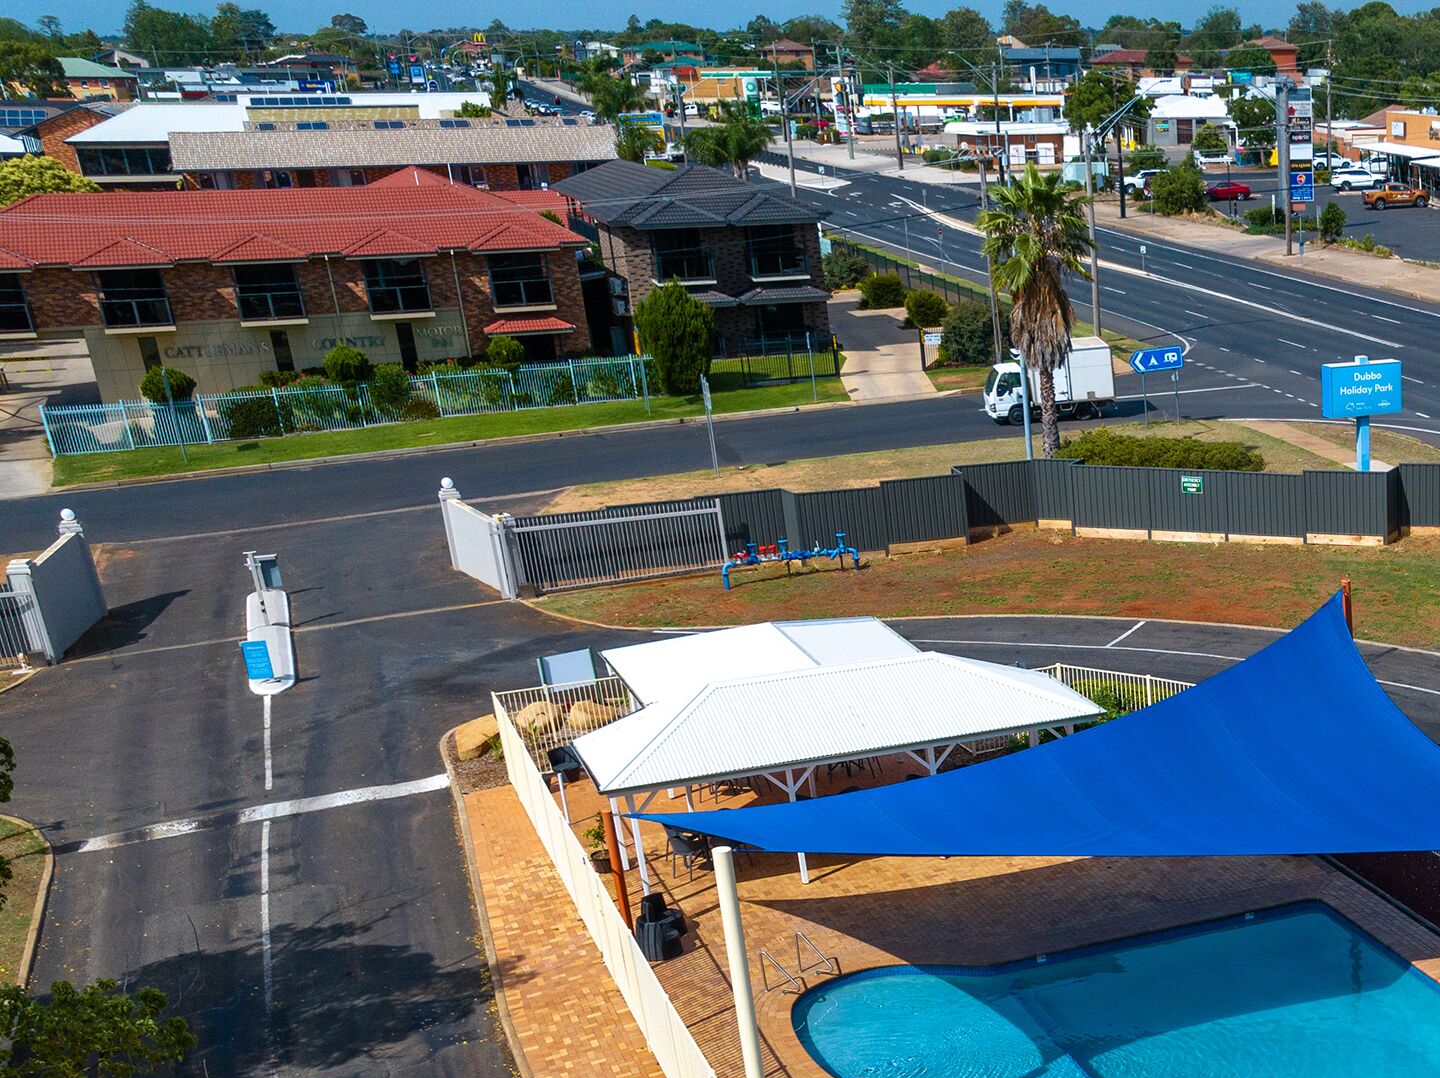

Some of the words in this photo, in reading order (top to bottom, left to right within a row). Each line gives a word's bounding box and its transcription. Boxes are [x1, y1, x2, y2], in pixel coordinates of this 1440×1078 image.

[416, 325, 462, 338] MOTOR
[164, 341, 272, 359] CATTLEMAN'S
[312, 335, 386, 351] COUNTRY
[1354, 372, 1382, 381] Dubbo
[1340, 385, 1373, 396] Holiday
[1374, 382, 1393, 392] Park
